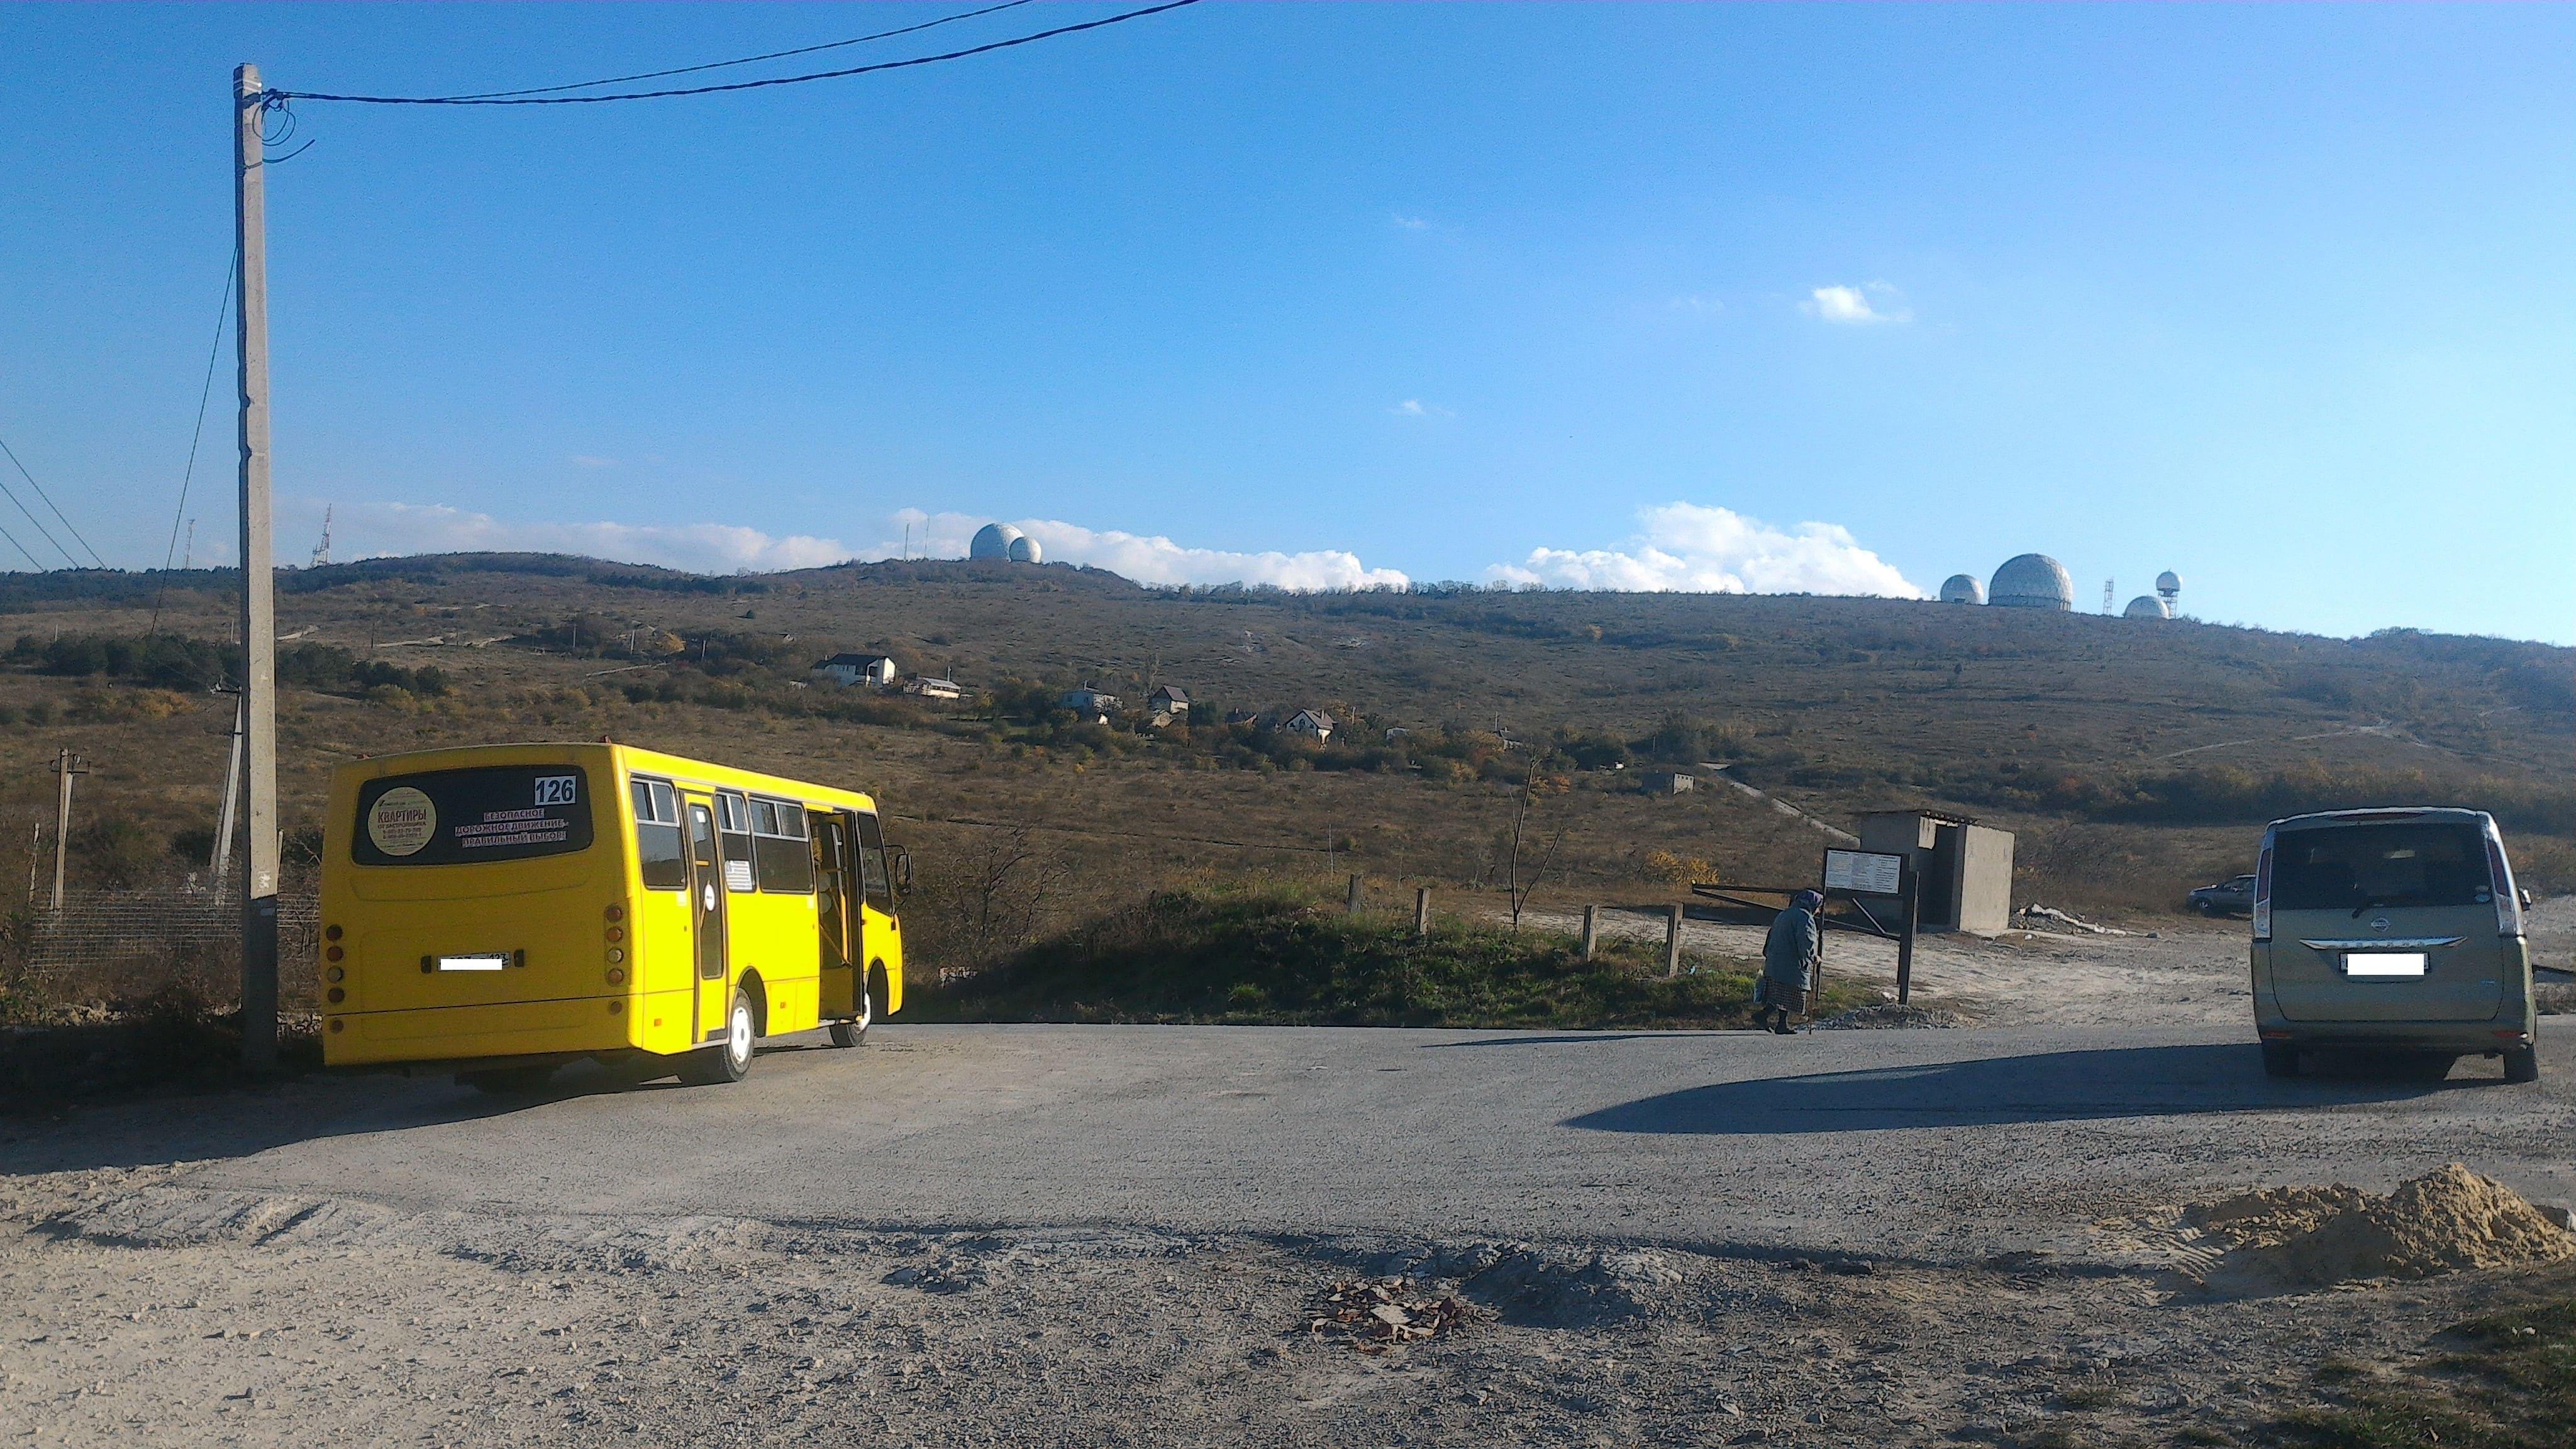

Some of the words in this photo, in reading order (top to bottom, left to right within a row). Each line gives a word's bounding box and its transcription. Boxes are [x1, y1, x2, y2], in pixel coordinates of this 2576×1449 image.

[536, 779, 574, 803] 126
[378, 809, 426, 823] КВАРТИРЫ
[485, 809, 543, 820] БЕЗОПАСНОЕ
[456, 824, 509, 835] ДОРОЖНОЕ
[464, 832, 528, 846] ПРАВИЛЬНЫЙ
